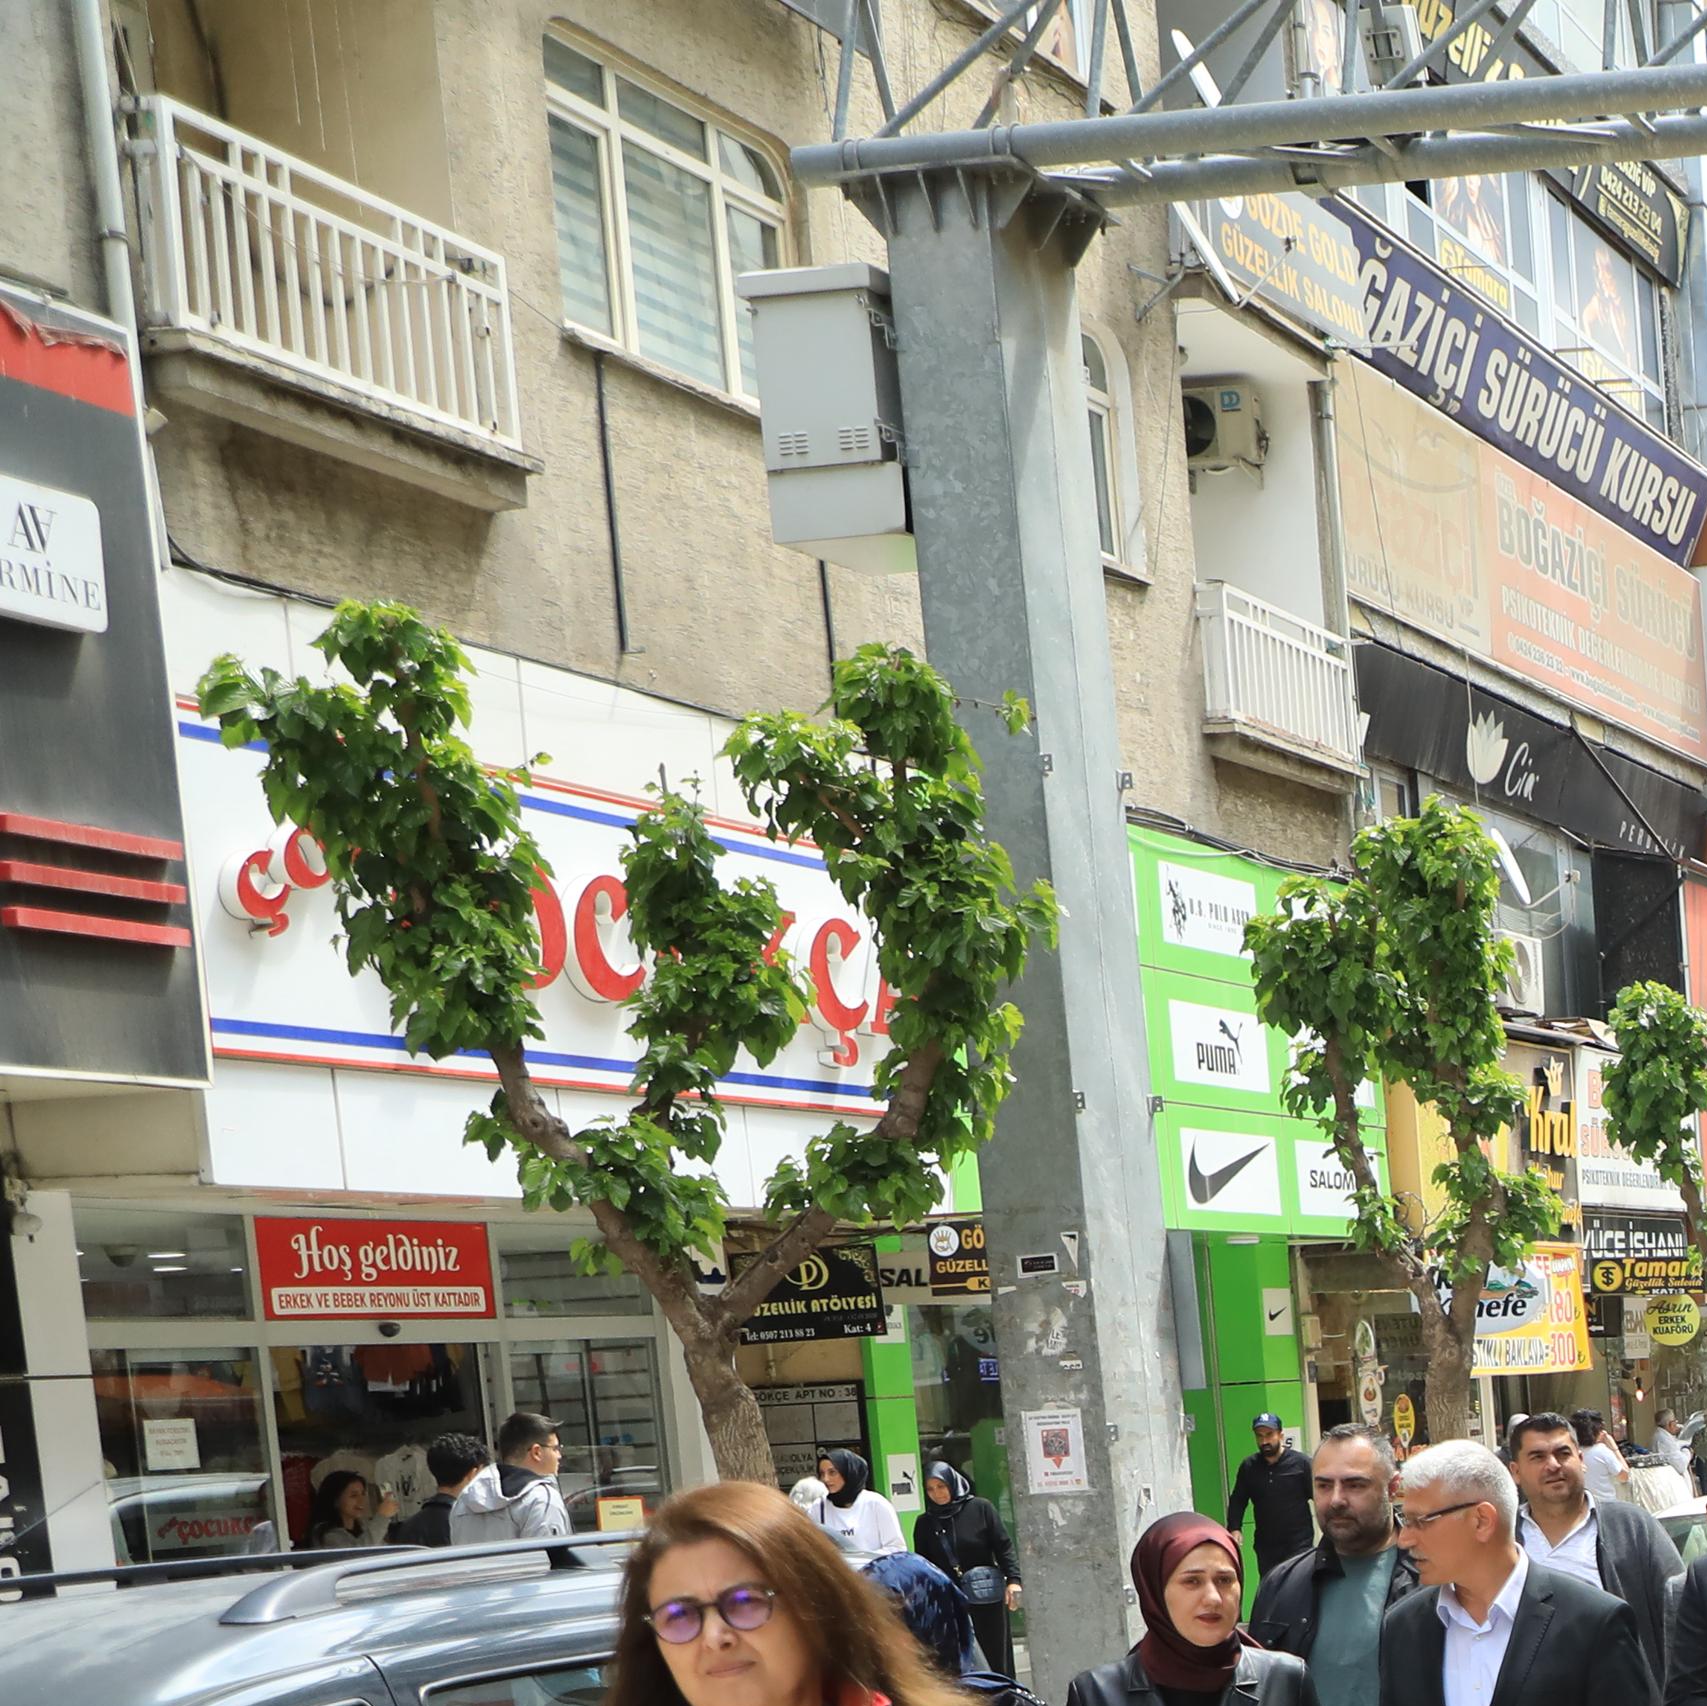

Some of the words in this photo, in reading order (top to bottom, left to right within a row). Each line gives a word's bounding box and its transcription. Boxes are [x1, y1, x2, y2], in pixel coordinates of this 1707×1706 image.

[1308, 223, 1357, 287] GOLD
[1221, 221, 1303, 303] GÜZELLİK
[1303, 276, 1365, 340] SALONU
[1359, 237, 1484, 408] ĞAZİÇİ
[1478, 346, 1608, 485] SÜRÜCÜ
[1600, 437, 1697, 546] KURSU
[0, 558, 101, 611] RMİNE
[1196, 1042, 1238, 1076] PUMA
[1524, 1085, 1577, 1159] Kral
[1309, 1168, 1357, 1193] SALOM
[290, 1224, 353, 1282] Hoş
[358, 1233, 461, 1282] geldiniz
[1583, 1219, 1626, 1259] YÜCE
[936, 1258, 989, 1274] GÜZELL
[1622, 1258, 1703, 1279] Tamara
[277, 1292, 314, 1310] ERKEK
[315, 1291, 330, 1308] VE
[333, 1291, 367, 1308] BEBEK
[370, 1291, 411, 1308] REYONU
[412, 1289, 432, 1308] ÜST
[434, 1291, 481, 1308] KATTADIR
[752, 1297, 807, 1318] ZELLİK
[811, 1292, 878, 1314] ATÖLYESİ
[1652, 1324, 1694, 1335] KUAFÖRÜ
[1658, 1315, 1687, 1325] ERKEK
[1550, 1332, 1576, 1366] 300
[795, 1389, 816, 1400] APT
